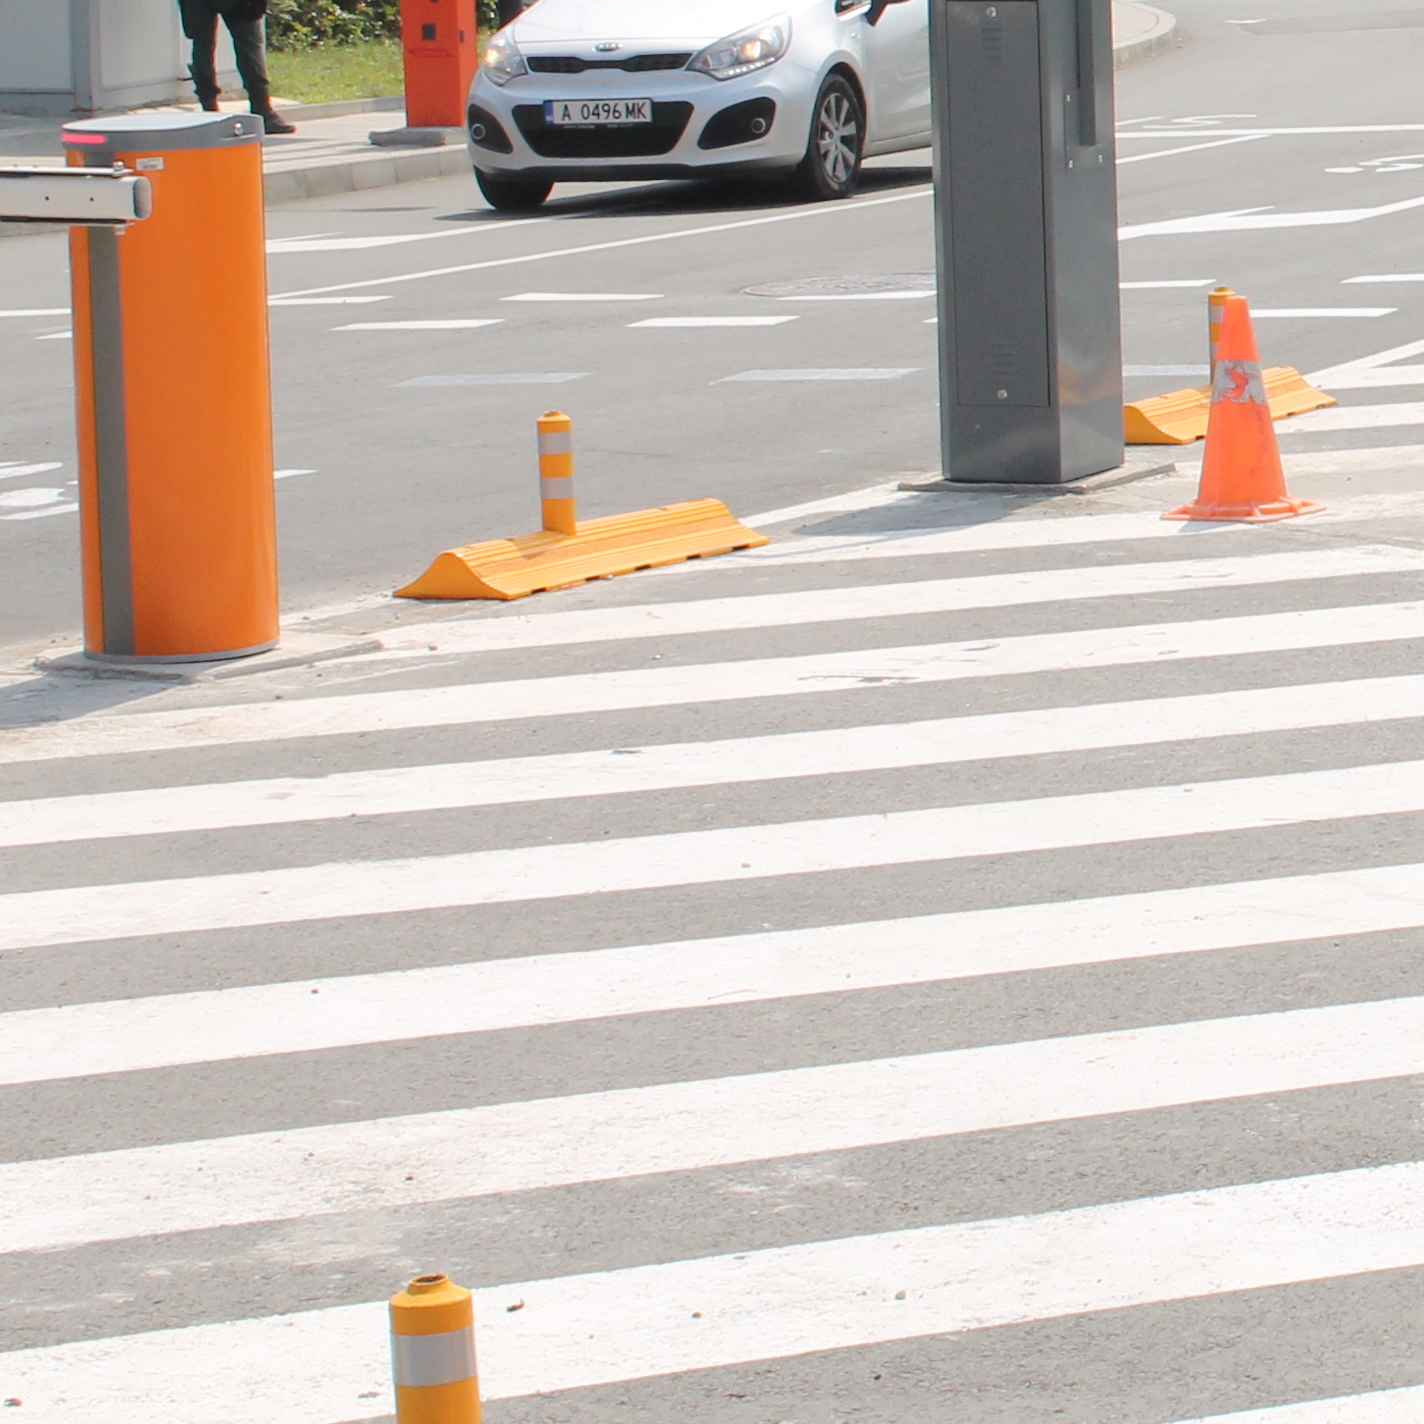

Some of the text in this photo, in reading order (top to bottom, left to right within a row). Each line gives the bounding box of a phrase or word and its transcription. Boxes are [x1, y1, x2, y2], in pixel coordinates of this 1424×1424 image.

[562, 102, 648, 121] A 0496 MK
